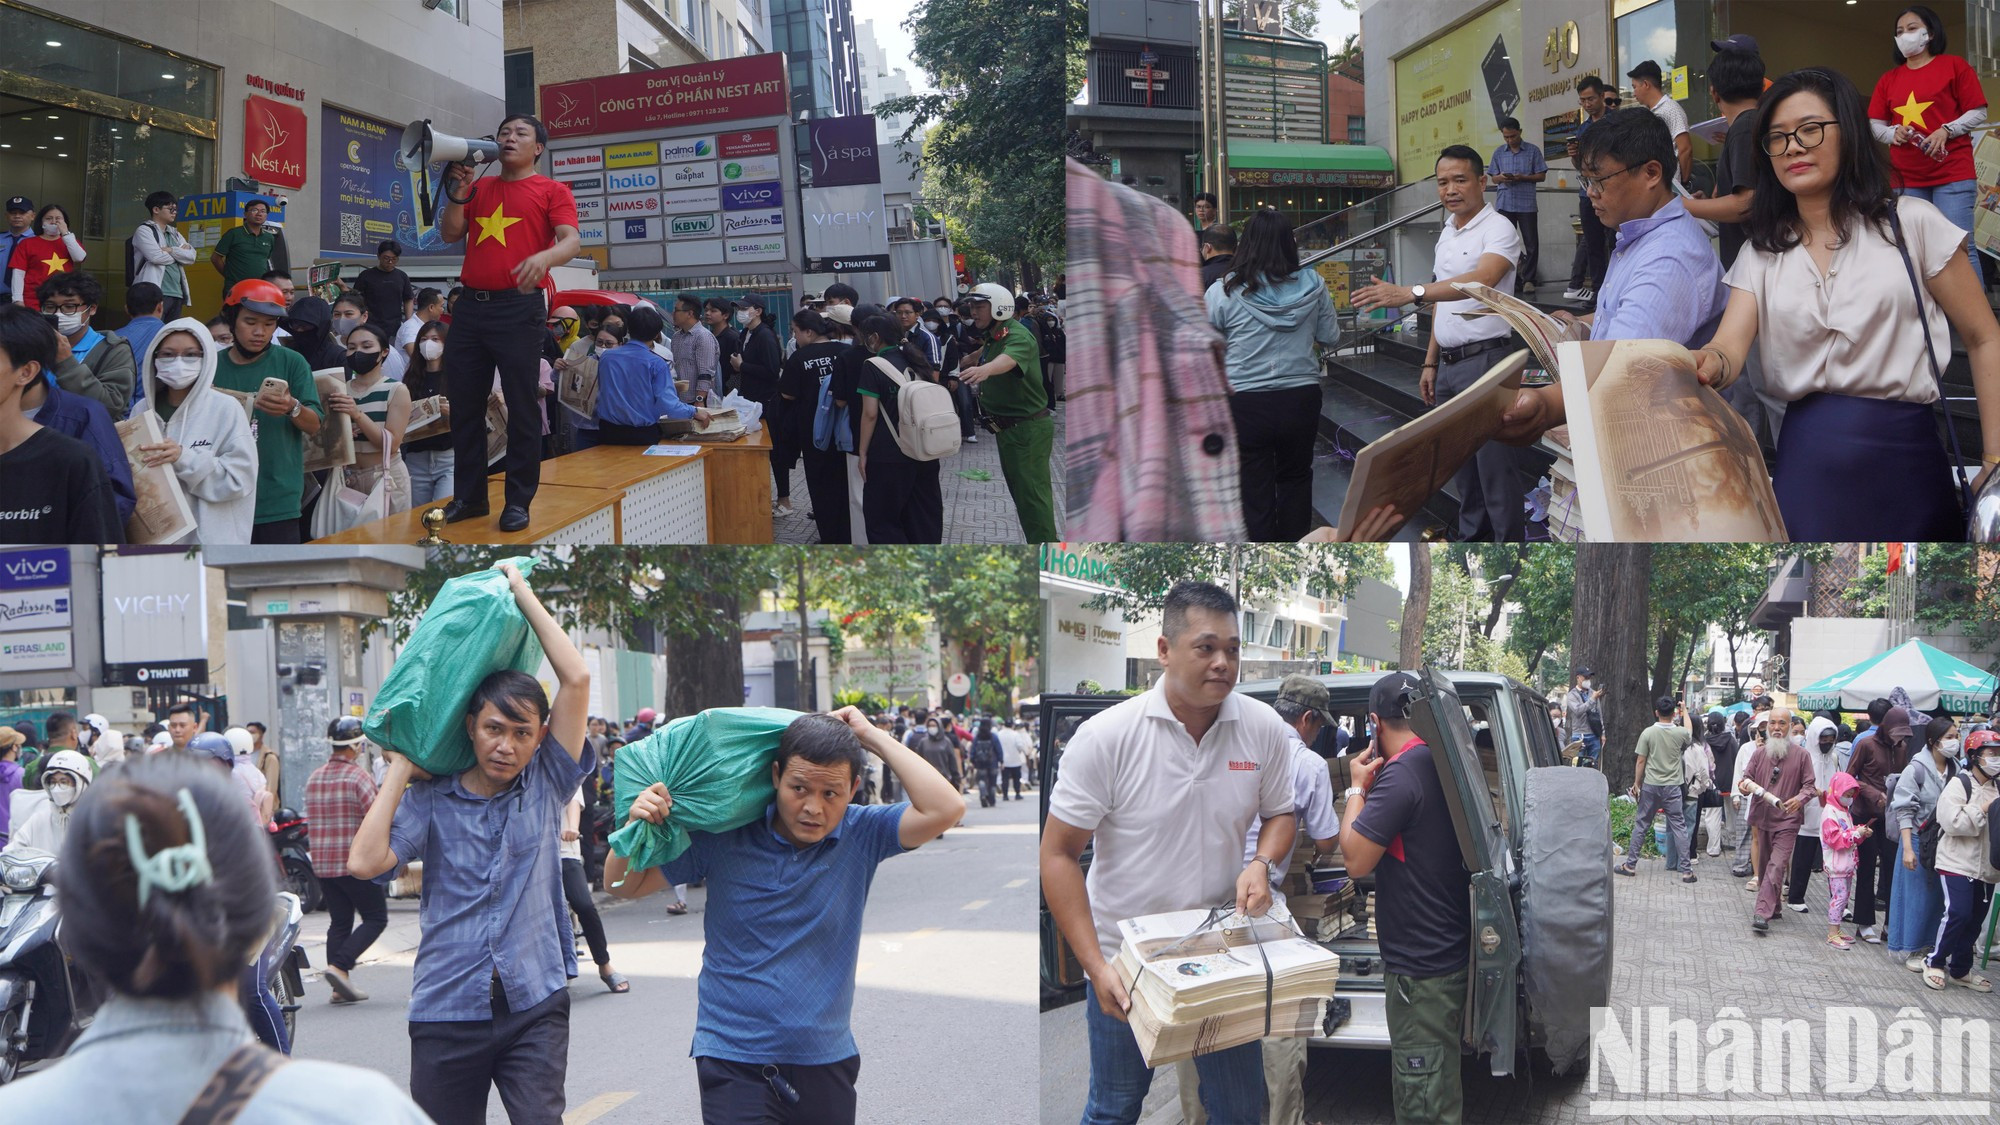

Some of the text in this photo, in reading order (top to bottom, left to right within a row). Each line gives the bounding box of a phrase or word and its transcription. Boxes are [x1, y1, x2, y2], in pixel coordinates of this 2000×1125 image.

[1543, 20, 1580, 74] 40
[647, 69, 725, 89] Đơn Vị Quản Lý
[600, 80, 780, 113] CÔNG TY CỔ PHẦN NEST ART
[1400, 109, 1419, 125] HAPPY
[1420, 102, 1437, 119] CARD
[1438, 89, 1471, 112] PLATINUM
[340, 115, 360, 127] NAM
[360, 122, 366, 130] A
[366, 123, 387, 136] BANK
[549, 116, 590, 130] Nest Art
[567, 156, 585, 165] Nhân
[587, 155, 601, 163] Dân
[665, 146, 694, 160] palma
[841, 146, 872, 162] spa
[251, 152, 300, 177] Nest Art
[675, 171, 705, 182] Giaphat
[1272, 172, 1303, 183] CAFE
[1306, 173, 1314, 183] &
[1316, 173, 1347, 183] JUICE
[340, 193, 353, 204] mọi
[731, 190, 771, 200] vivo
[185, 197, 227, 218] ATM
[609, 201, 644, 211] MIMS
[675, 221, 707, 231] KBVN
[725, 216, 771, 232] Radisson
[812, 210, 875, 226] VICHY
[627, 225, 645, 233] ATS
[738, 243, 780, 252] ERASLAND
[803, 357, 831, 371] AFTER
[5, 558, 57, 575] vivo
[0, 599, 54, 620] Radisson
[114, 593, 191, 614] VICHY
[1058, 618, 1086, 636] NHG
[1093, 625, 1122, 641] iTower
[13, 642, 65, 654] ERASLAND
[150, 668, 189, 679] THAIYEN
[1941, 694, 1989, 713] Heine
